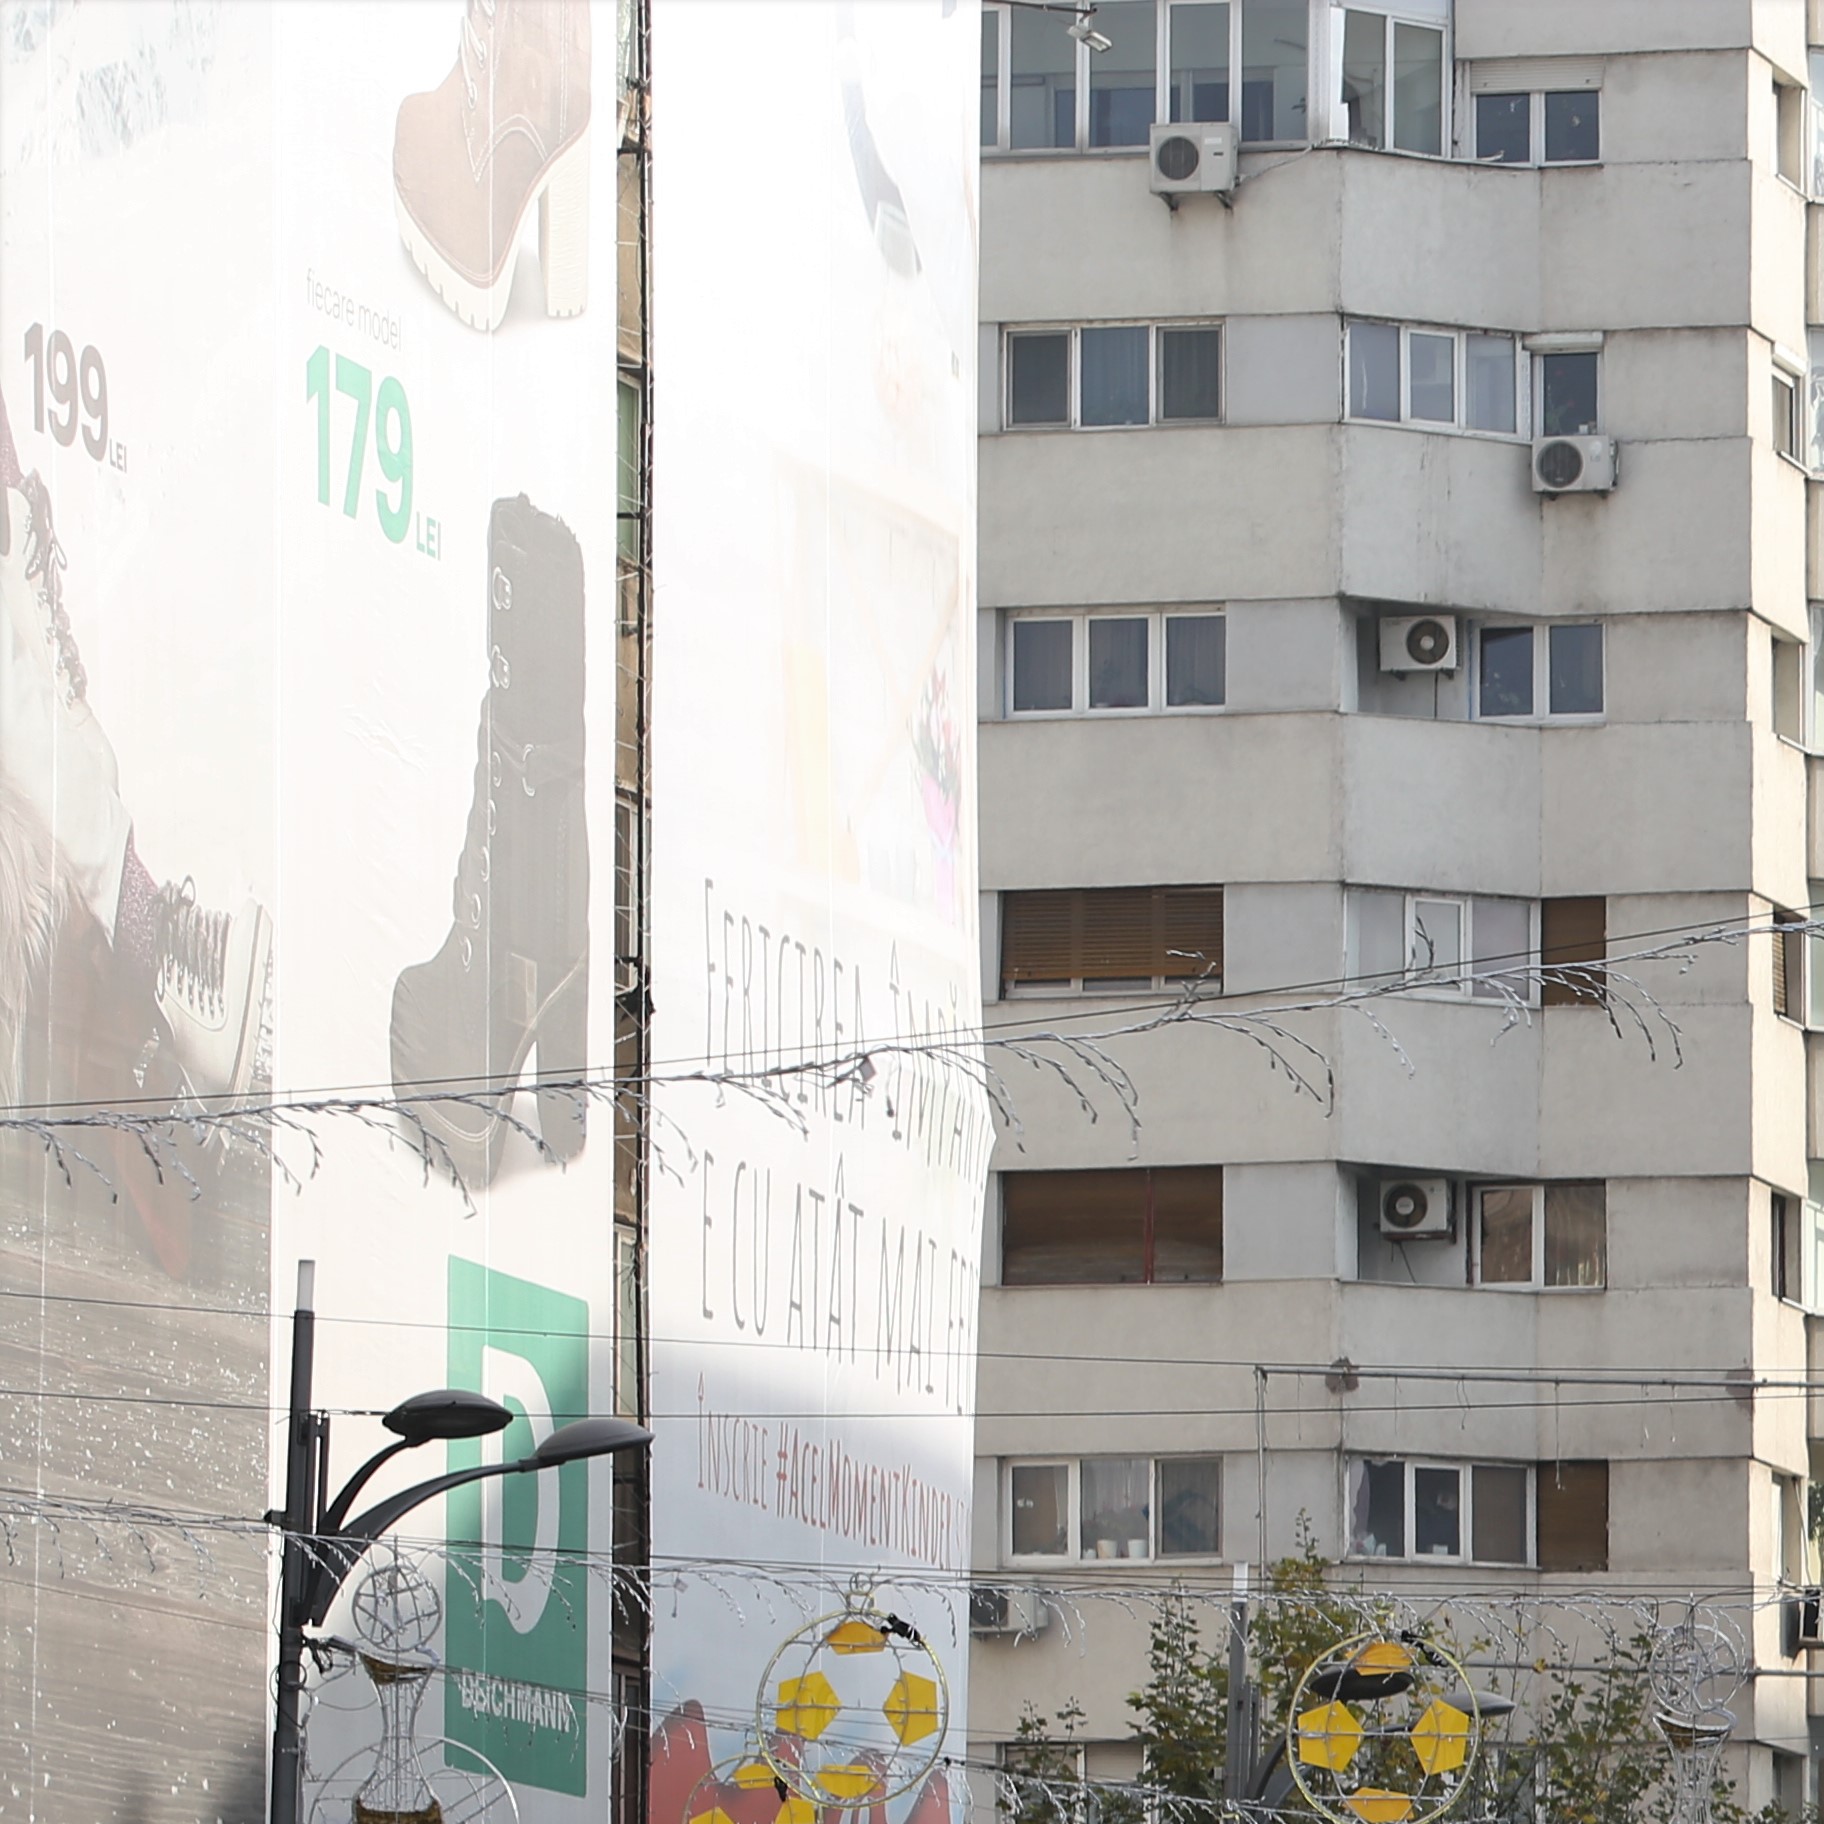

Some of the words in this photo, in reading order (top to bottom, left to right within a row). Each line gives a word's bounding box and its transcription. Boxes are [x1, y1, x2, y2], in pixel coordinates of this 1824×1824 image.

[306, 267, 354, 327] fiecare
[24, 321, 109, 462] 199
[109, 438, 127, 474] LEI
[306, 344, 414, 545] 179
[416, 510, 442, 562] LEI
[704, 876, 867, 1130] FERICIREA
[701, 1148, 714, 1320] E
[732, 1160, 770, 1336] CU
[786, 1152, 865, 1365] ATÂT
[875, 1216, 938, 1396] MAI
[696, 1371, 769, 1511] ÎNSCRIE
[776, 1420, 953, 1571] #ACELMOMENTKINDER
[461, 1667, 571, 1733] DEICHMANN
